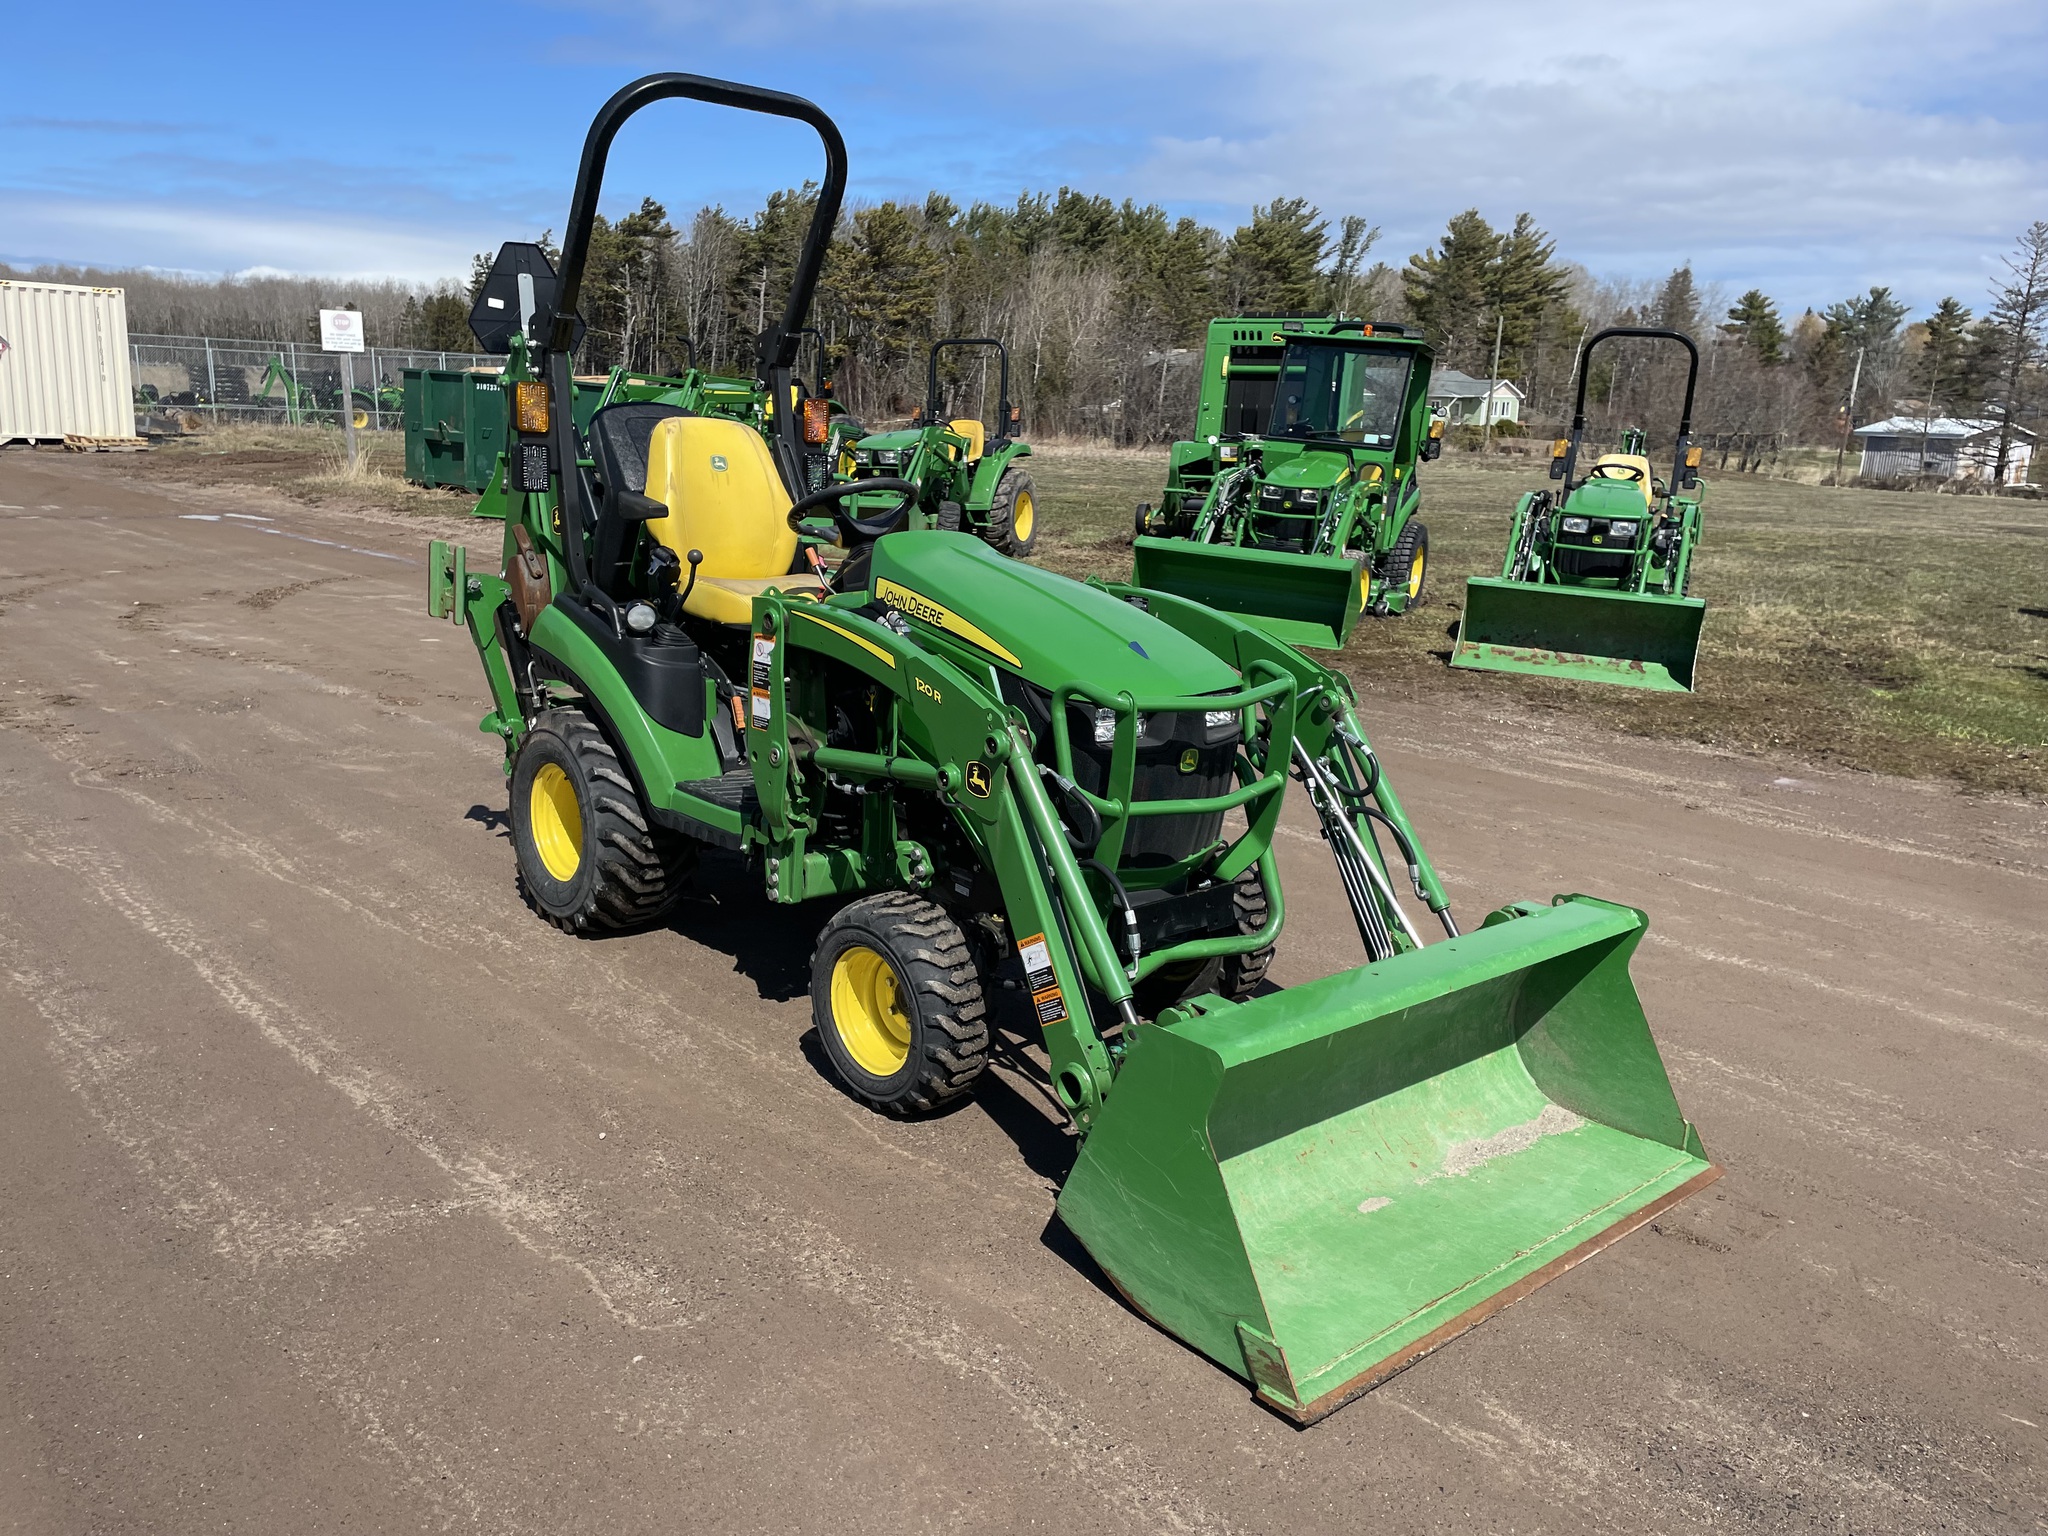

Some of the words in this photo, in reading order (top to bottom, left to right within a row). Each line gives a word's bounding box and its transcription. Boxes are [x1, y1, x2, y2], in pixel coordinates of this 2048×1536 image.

[334, 318, 349, 326] STOP
[883, 587, 907, 608] JOHN
[908, 597, 944, 624] DEERE
